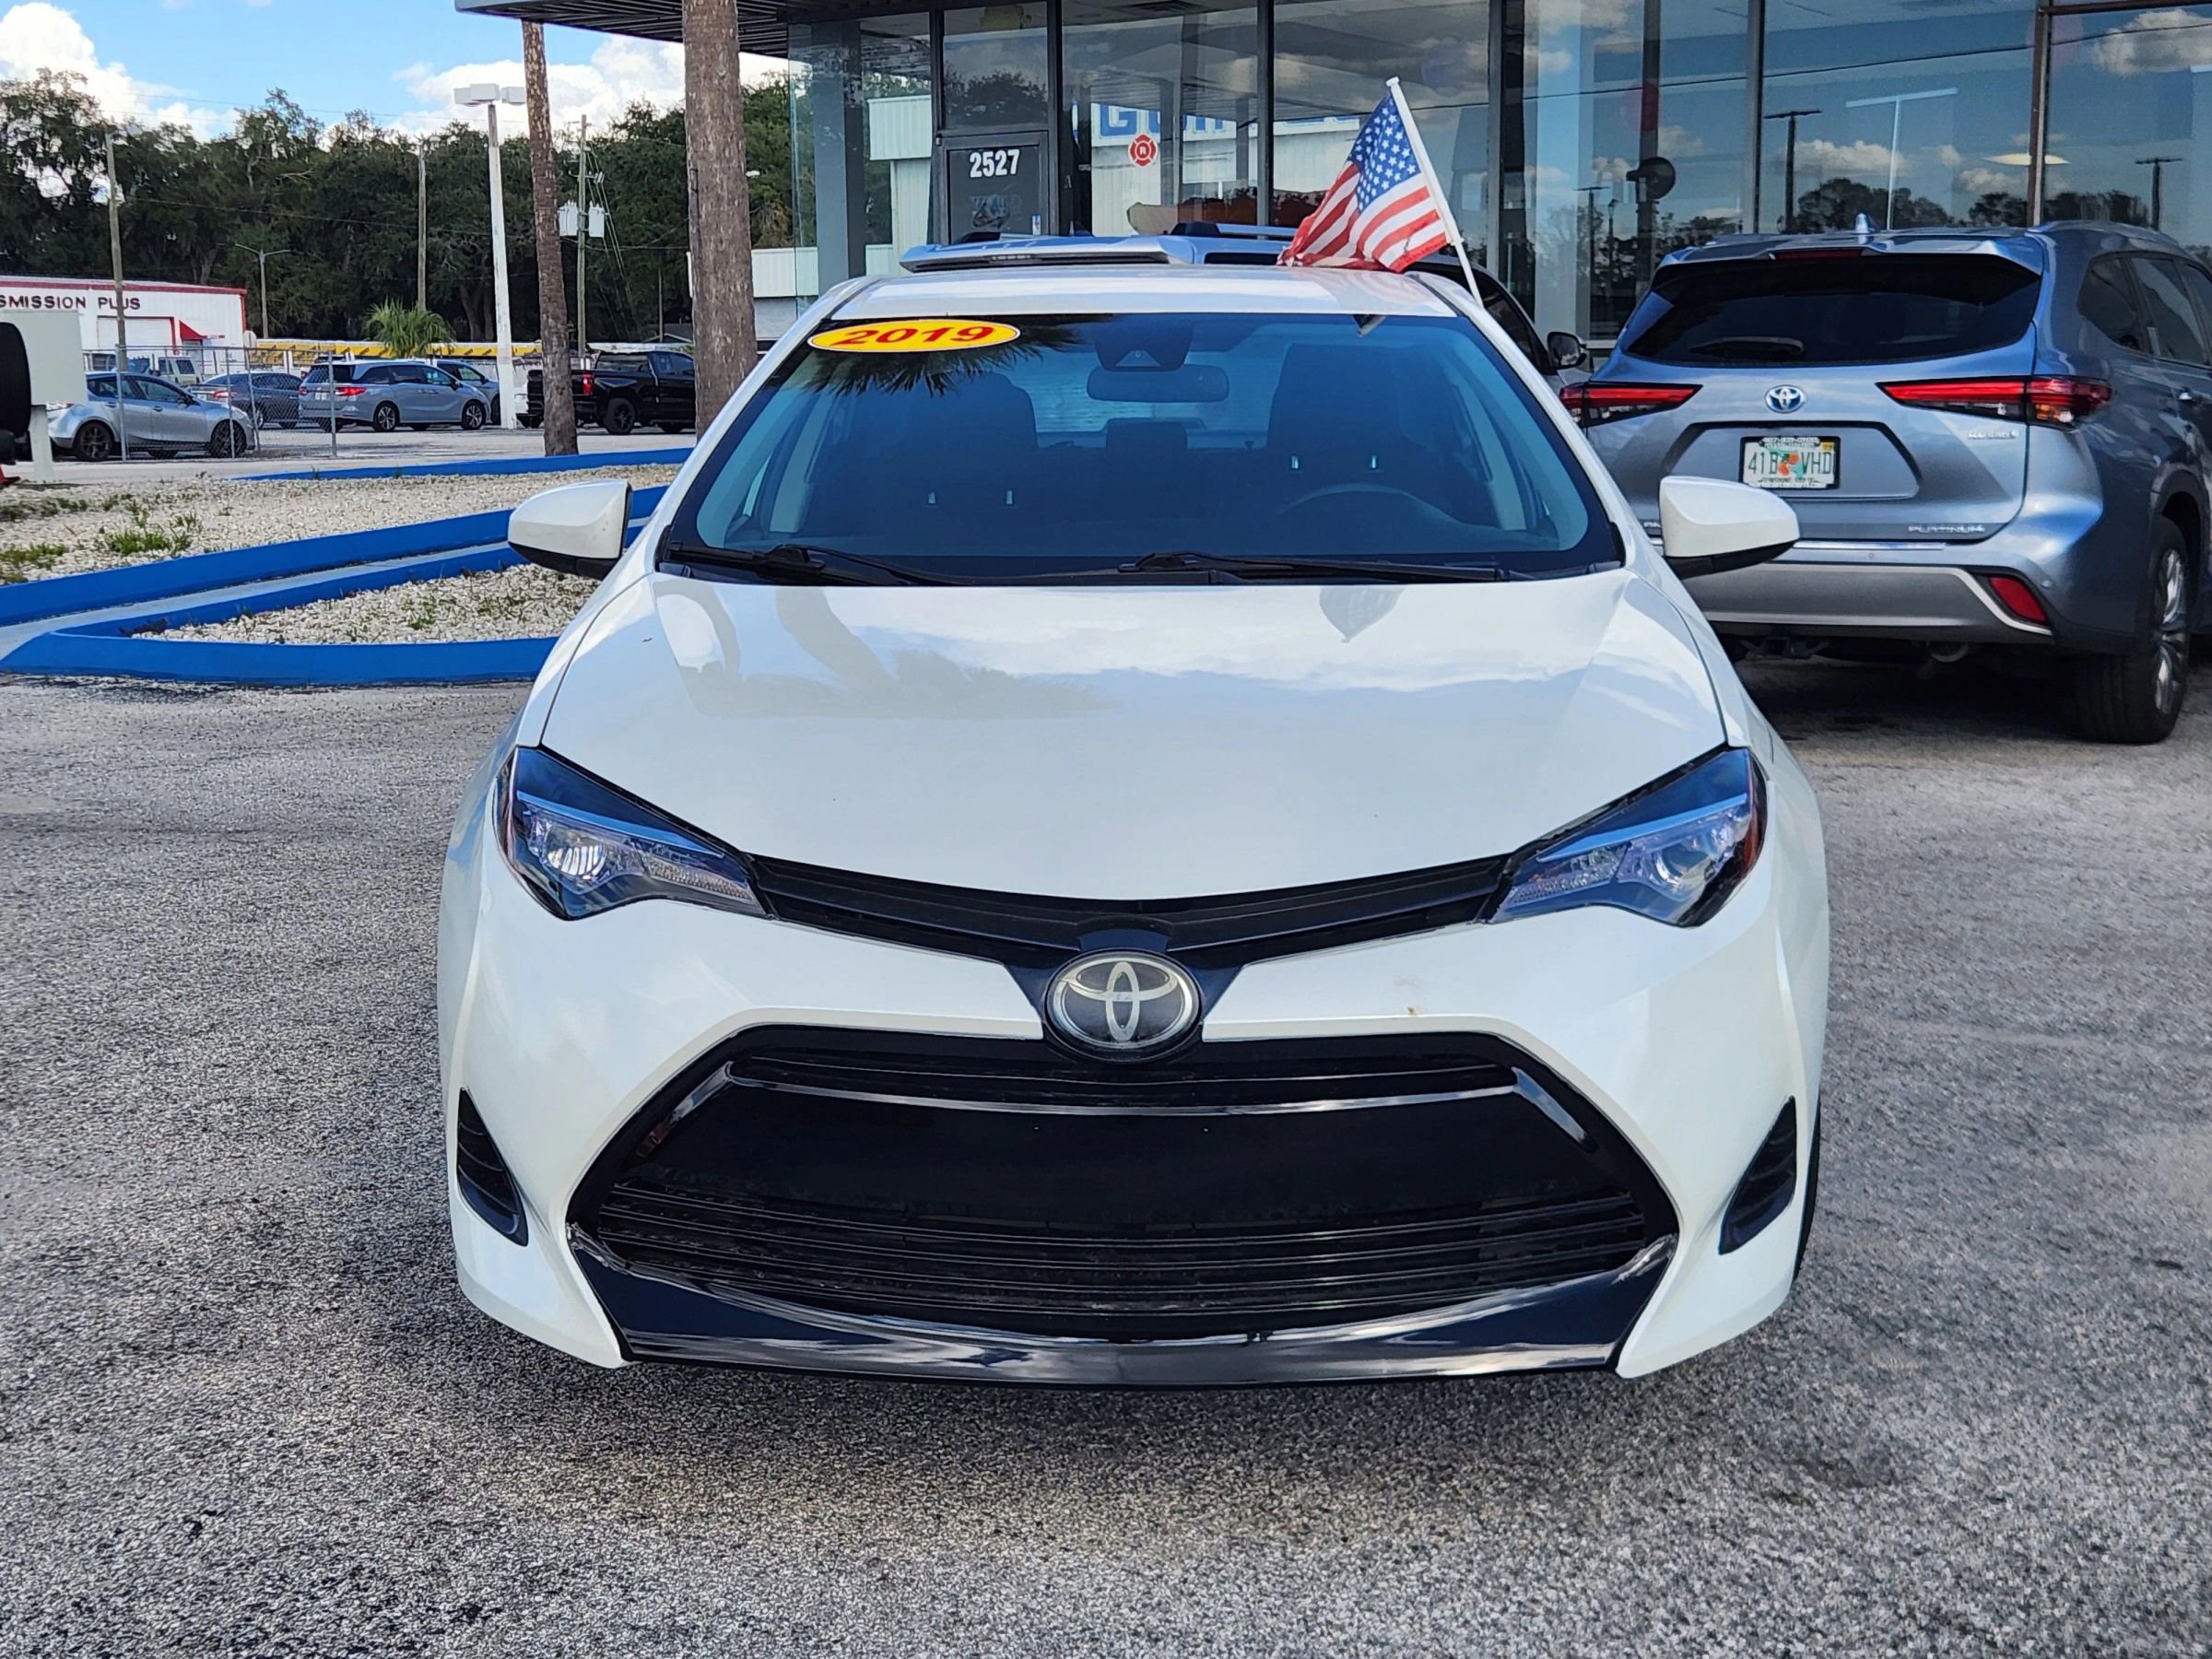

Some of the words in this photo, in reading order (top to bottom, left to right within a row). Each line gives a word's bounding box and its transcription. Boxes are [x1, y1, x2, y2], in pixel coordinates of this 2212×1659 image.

[970, 148, 1020, 178] 2527
[98, 297, 141, 310] PLUS
[830, 326, 994, 346] 2019
